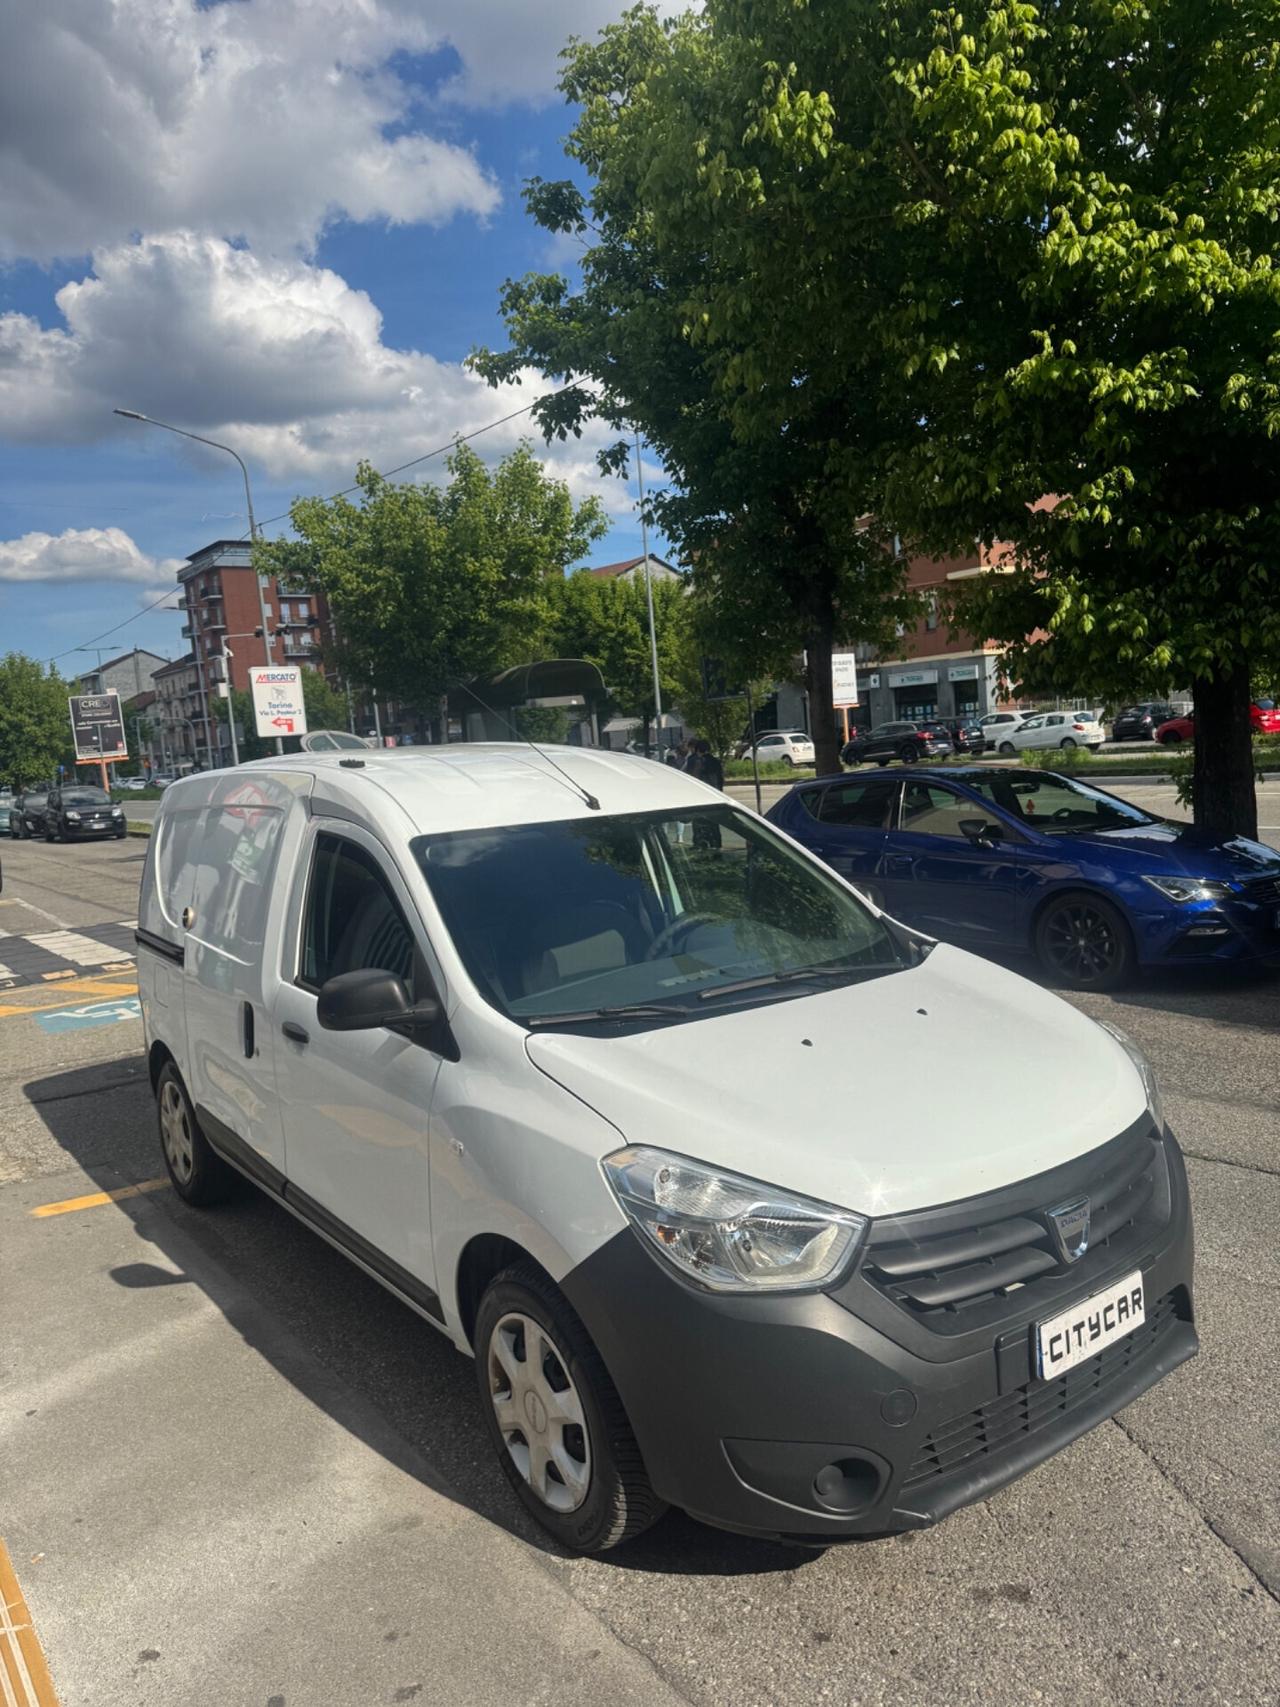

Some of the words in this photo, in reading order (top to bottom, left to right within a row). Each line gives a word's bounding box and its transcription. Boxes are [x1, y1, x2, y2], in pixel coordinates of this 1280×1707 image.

[256, 673, 297, 683] MERCATO
[268, 701, 293, 709] Torino
[1049, 1287, 1142, 1363] CITYCAR
